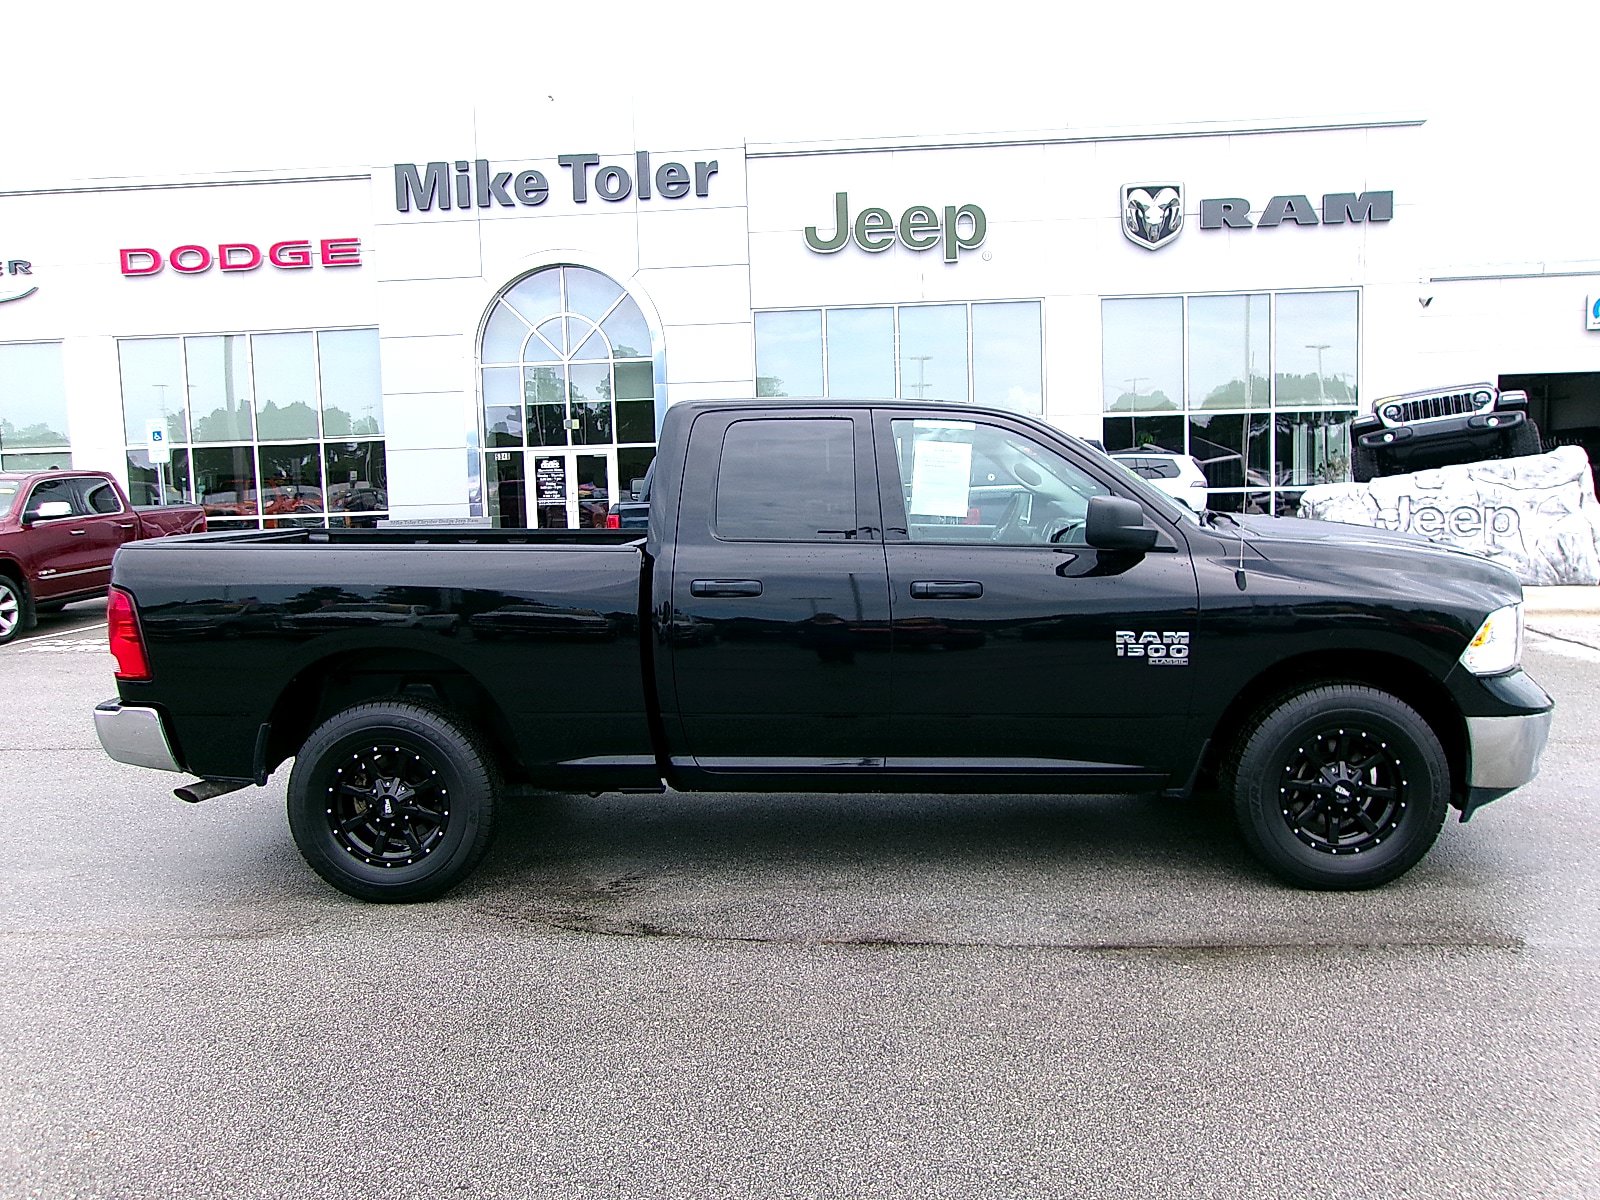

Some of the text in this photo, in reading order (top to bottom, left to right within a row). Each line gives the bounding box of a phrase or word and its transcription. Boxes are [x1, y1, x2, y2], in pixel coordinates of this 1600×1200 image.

[394, 150, 719, 211] Mike Toler
[802, 191, 988, 264] Jeep
[1198, 189, 1394, 230] RAM
[119, 237, 363, 277] DODGE
[1377, 495, 1519, 546] Jeep
[1115, 631, 1189, 644] RAM
[1115, 645, 1189, 657] 1500
